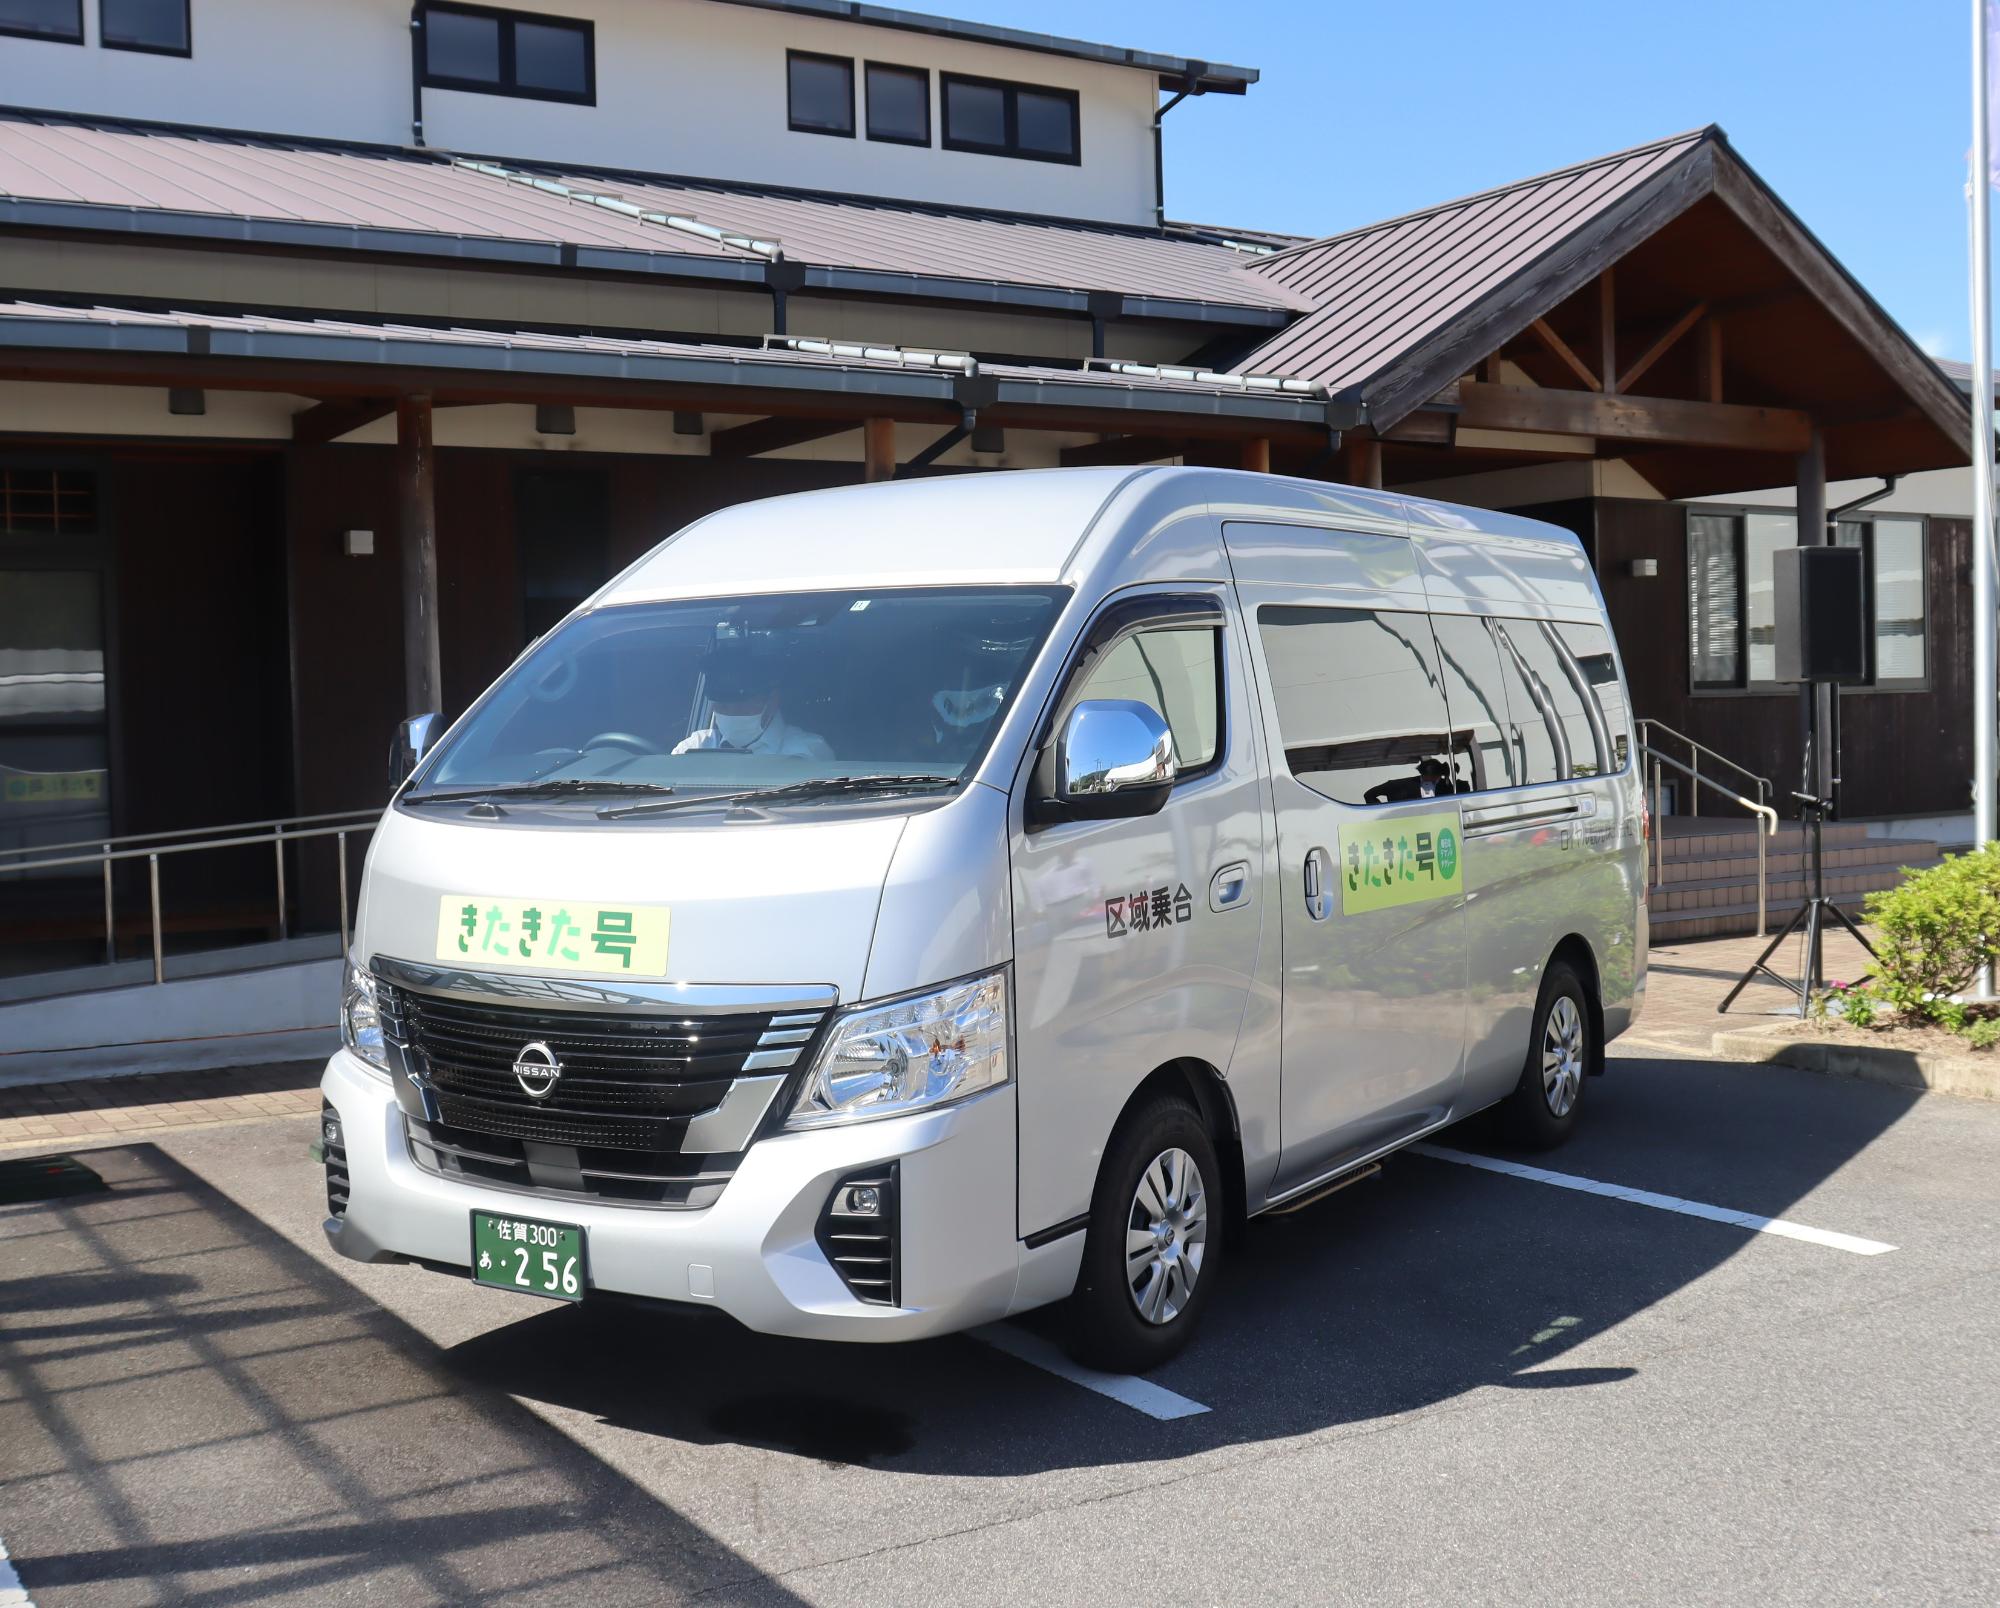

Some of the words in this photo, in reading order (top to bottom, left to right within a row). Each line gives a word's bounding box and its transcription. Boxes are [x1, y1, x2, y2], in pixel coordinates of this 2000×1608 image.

[1348, 832, 1435, 891] きたきた号
[458, 904, 637, 968] きたきた号
[1105, 882, 1192, 939] 区域乗合
[513, 1064, 560, 1078] NISSAN
